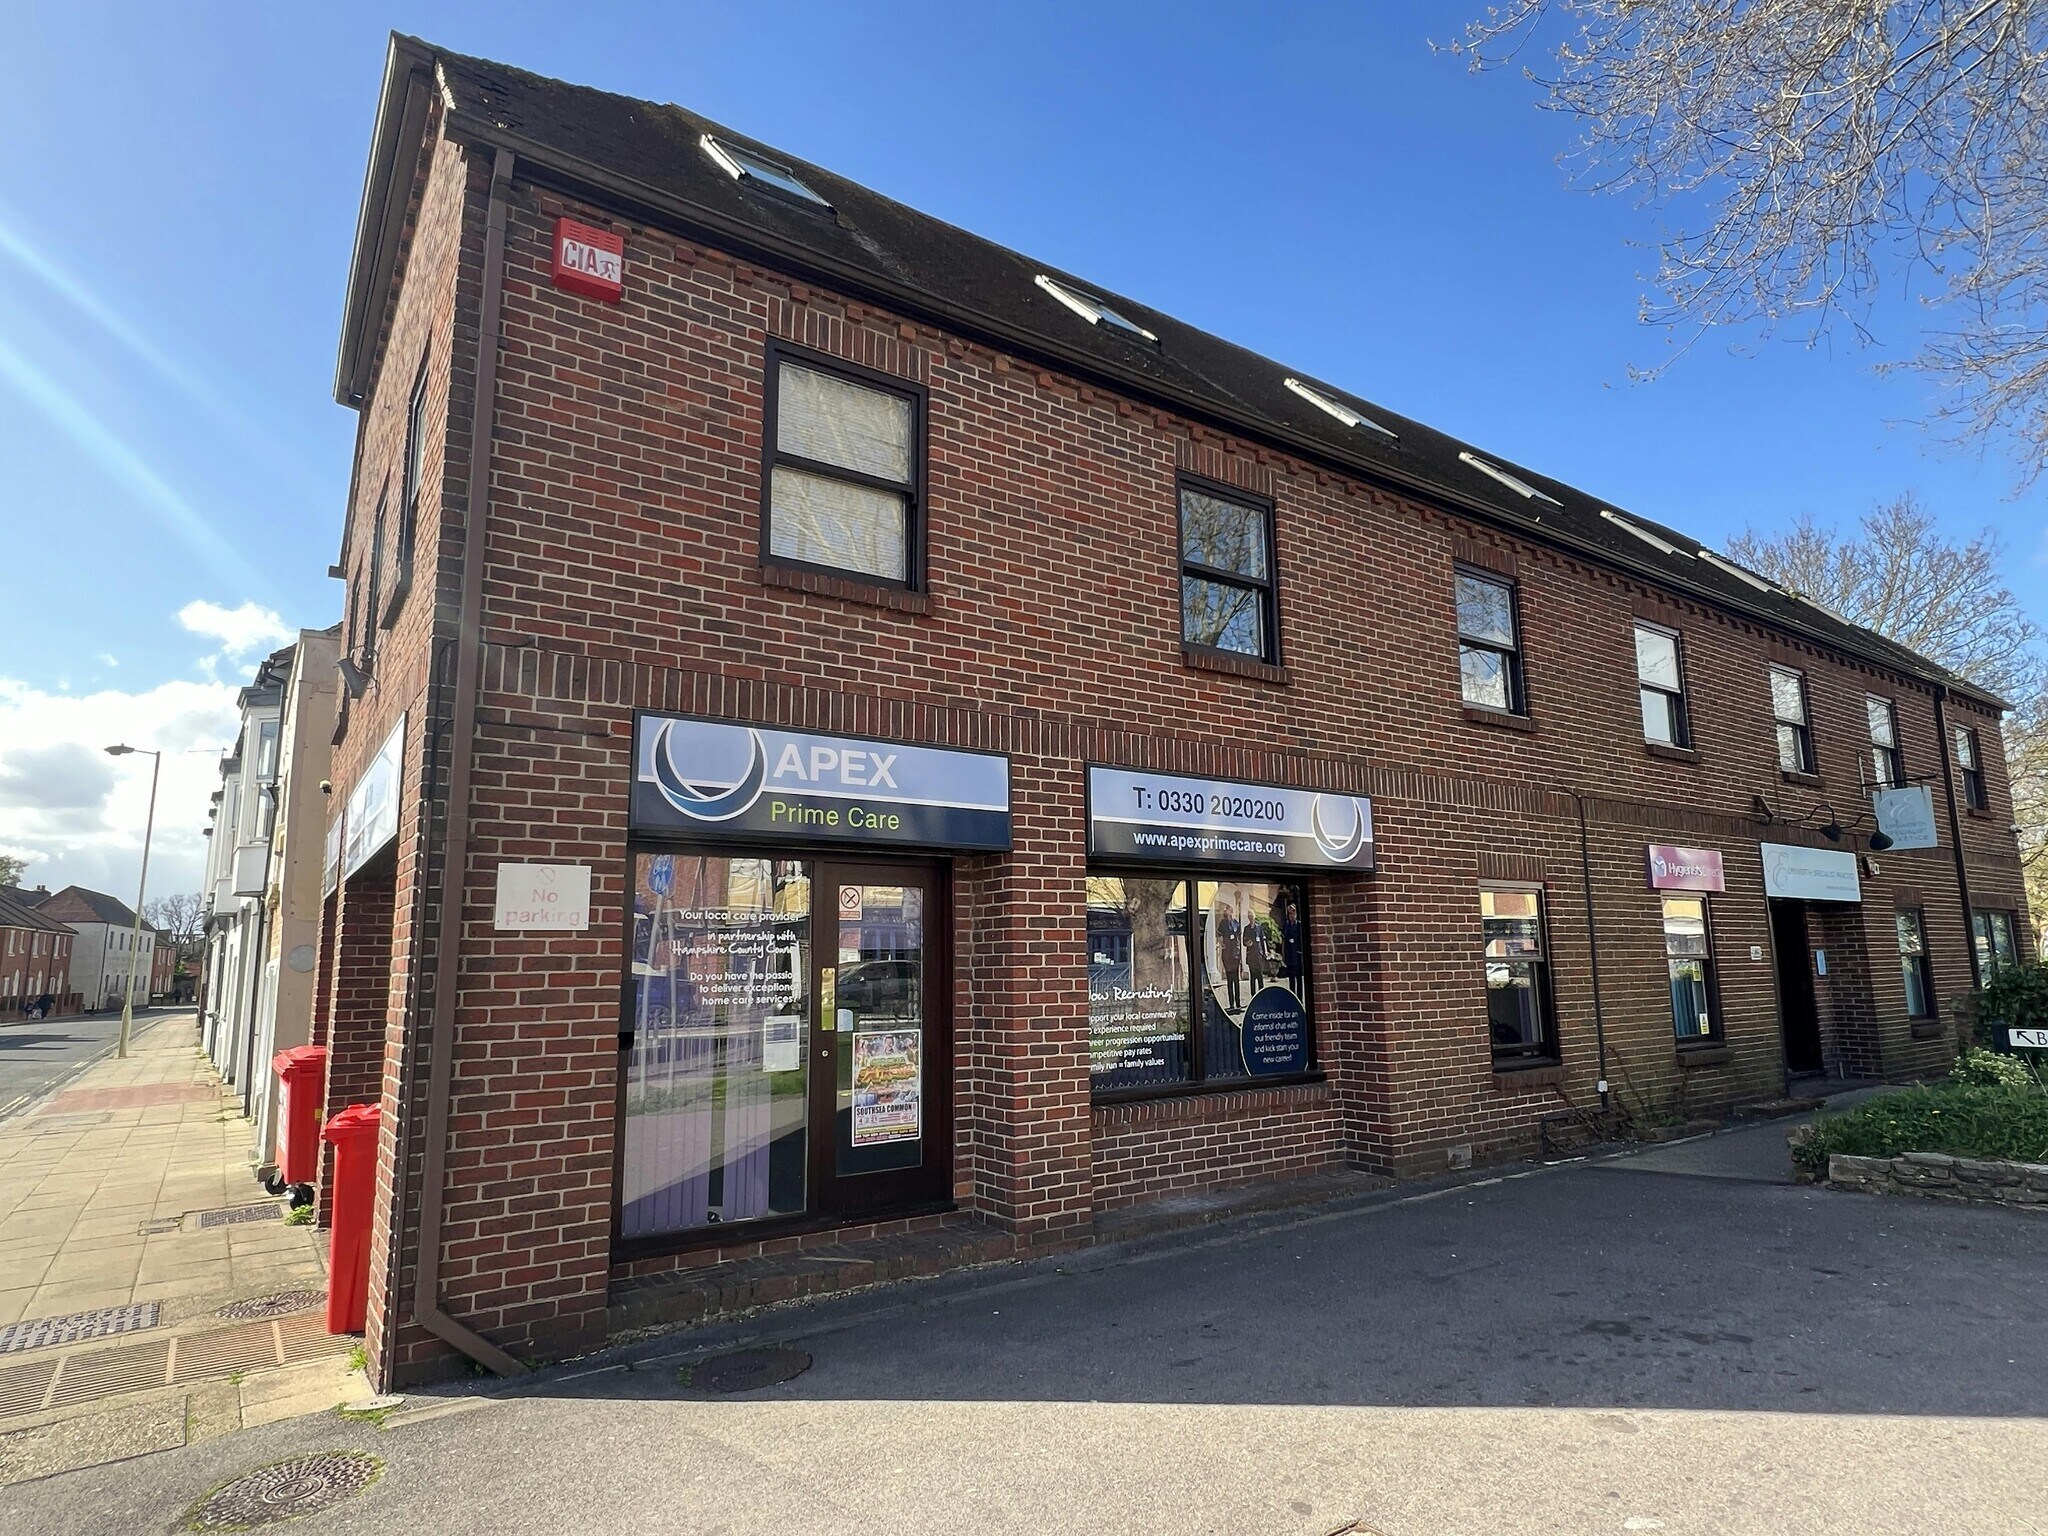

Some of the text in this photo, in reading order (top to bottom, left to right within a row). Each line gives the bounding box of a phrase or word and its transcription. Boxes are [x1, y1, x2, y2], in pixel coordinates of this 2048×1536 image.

[563, 241, 598, 273] CIA
[773, 743, 898, 789] APEX
[1133, 786, 1285, 821] T: 0330 2020200
[771, 801, 900, 830] Prime Care
[1133, 832, 1286, 857] www.apexprimecare.org
[532, 889, 559, 903] No
[505, 908, 580, 926] parking
[679, 910, 799, 923] Your local care provider
[707, 929, 796, 944] in partnership with
[671, 940, 727, 958] Hampshire
[728, 942, 764, 958] County
[690, 972, 703, 981] Do
[705, 973, 723, 983] you
[725, 972, 748, 981] have
[699, 984, 708, 993] to
[711, 984, 741, 993] deliver
[1113, 983, 1174, 1004] Recruiting!
[702, 997, 730, 1006] home
[1089, 1010, 1177, 1024] pport your local community
[1251, 1012, 1268, 1020] Come
[1094, 1025, 1129, 1035] experience
[1130, 1022, 1156, 1033] required
[1105, 1036, 1142, 1047] progression
[1143, 1033, 1185, 1044] opportunities
[1124, 1049, 1136, 1057] pay
[1137, 1047, 1152, 1055] rates
[1253, 1045, 1264, 1054] and
[1106, 1062, 1117, 1070] run
[1124, 1060, 1144, 1069] family
[1144, 1058, 1165, 1067] values
[856, 1104, 912, 1116] SOUTHSEA COMMON
